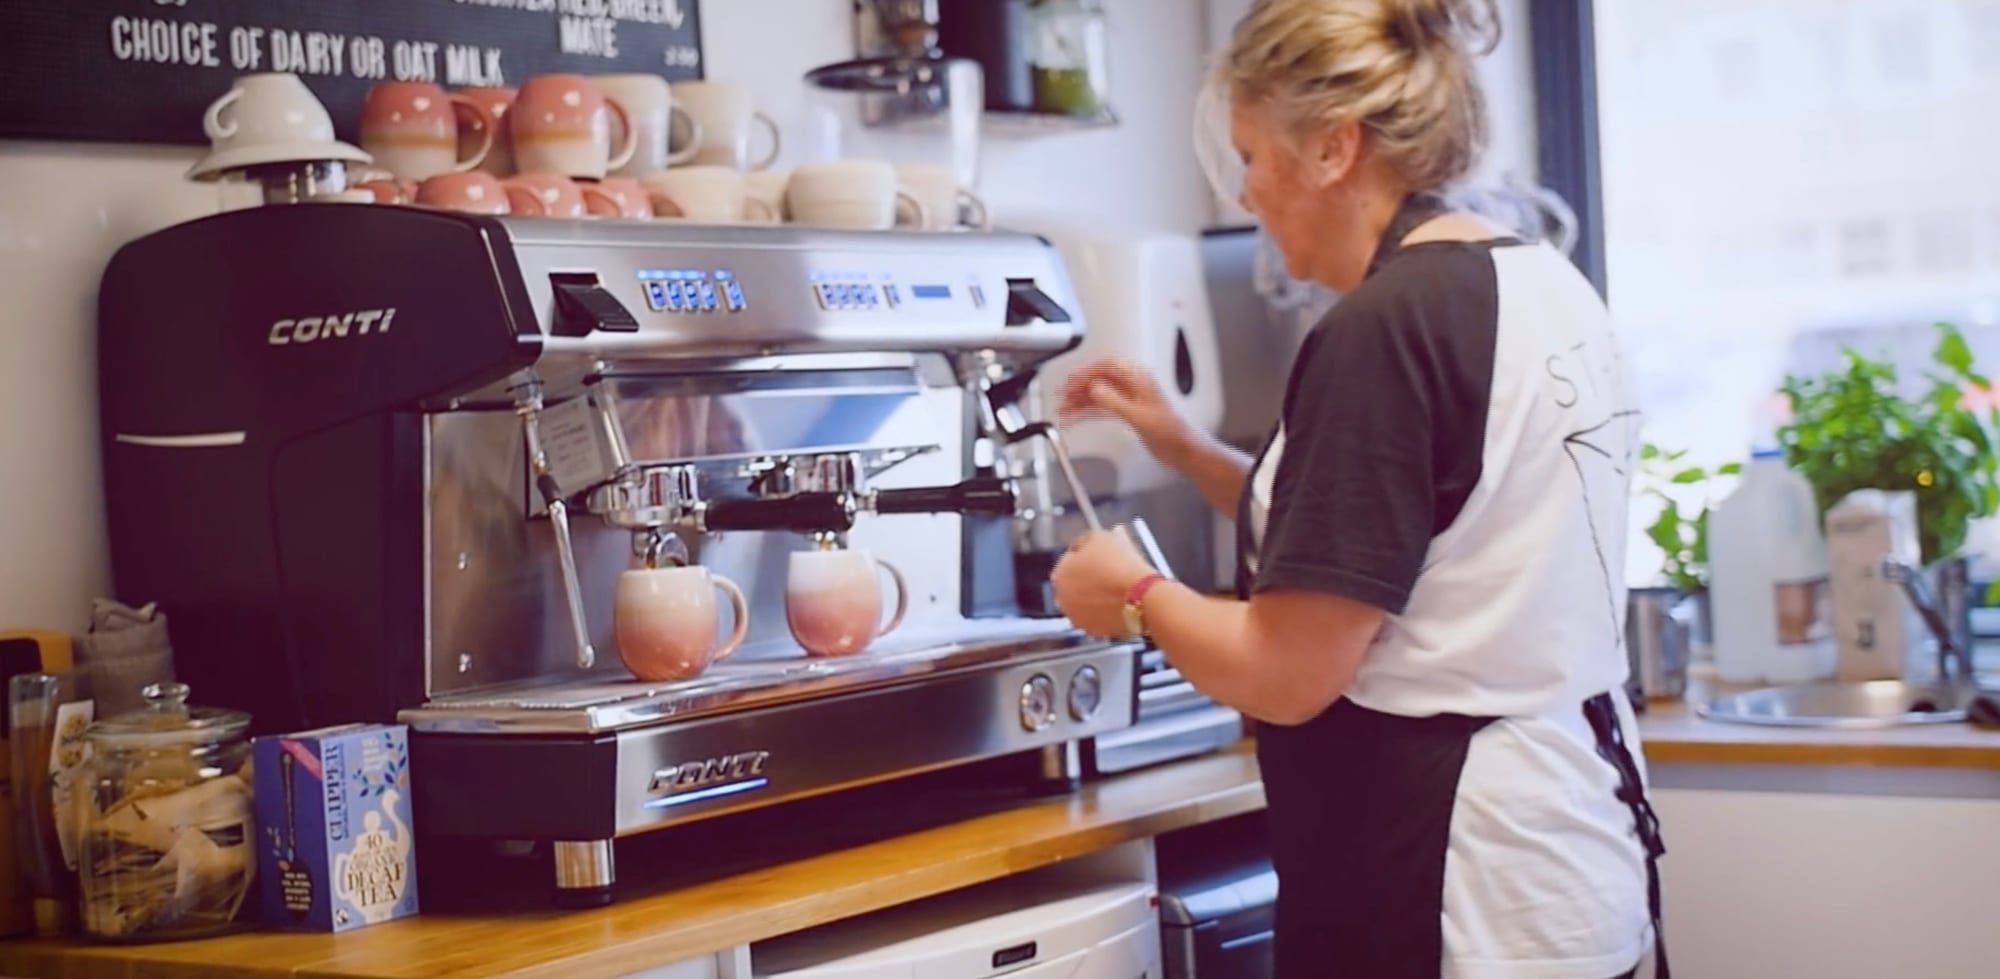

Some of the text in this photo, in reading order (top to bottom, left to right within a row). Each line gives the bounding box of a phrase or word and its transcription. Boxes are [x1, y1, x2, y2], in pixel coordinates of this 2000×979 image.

[111, 15, 504, 87] CHOICE OF DAIRY OR OAT MILK
[559, 15, 618, 58] MATE
[268, 307, 397, 346] CONTI
[325, 744, 344, 842] CLIPPER
[647, 750, 769, 794] CONTI
[347, 863, 404, 892] DECAF
[359, 883, 398, 907] TEA
